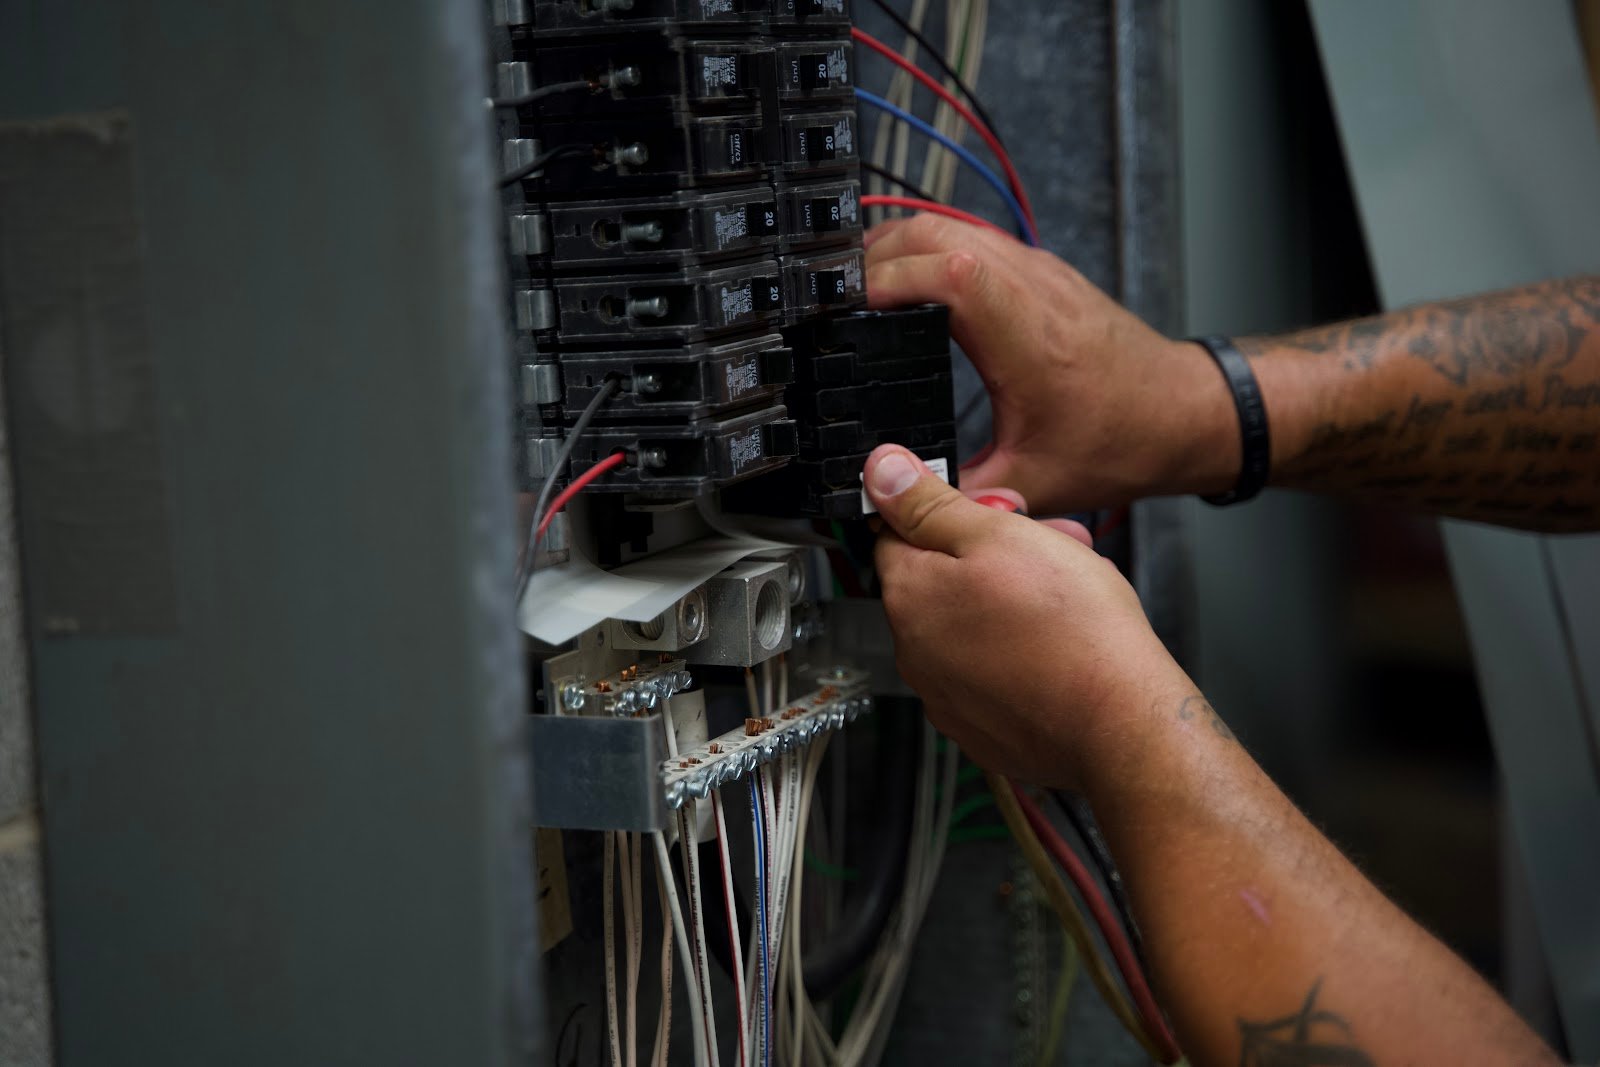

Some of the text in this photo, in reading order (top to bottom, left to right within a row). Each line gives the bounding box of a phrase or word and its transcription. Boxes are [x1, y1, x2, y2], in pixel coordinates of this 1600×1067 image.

[818, 63, 827, 79] 20
[825, 135, 834, 151] 20
[764, 211, 774, 227] 20
[831, 206, 840, 221] 20
[769, 285, 779, 302] 20
[836, 278, 845, 294] 20
